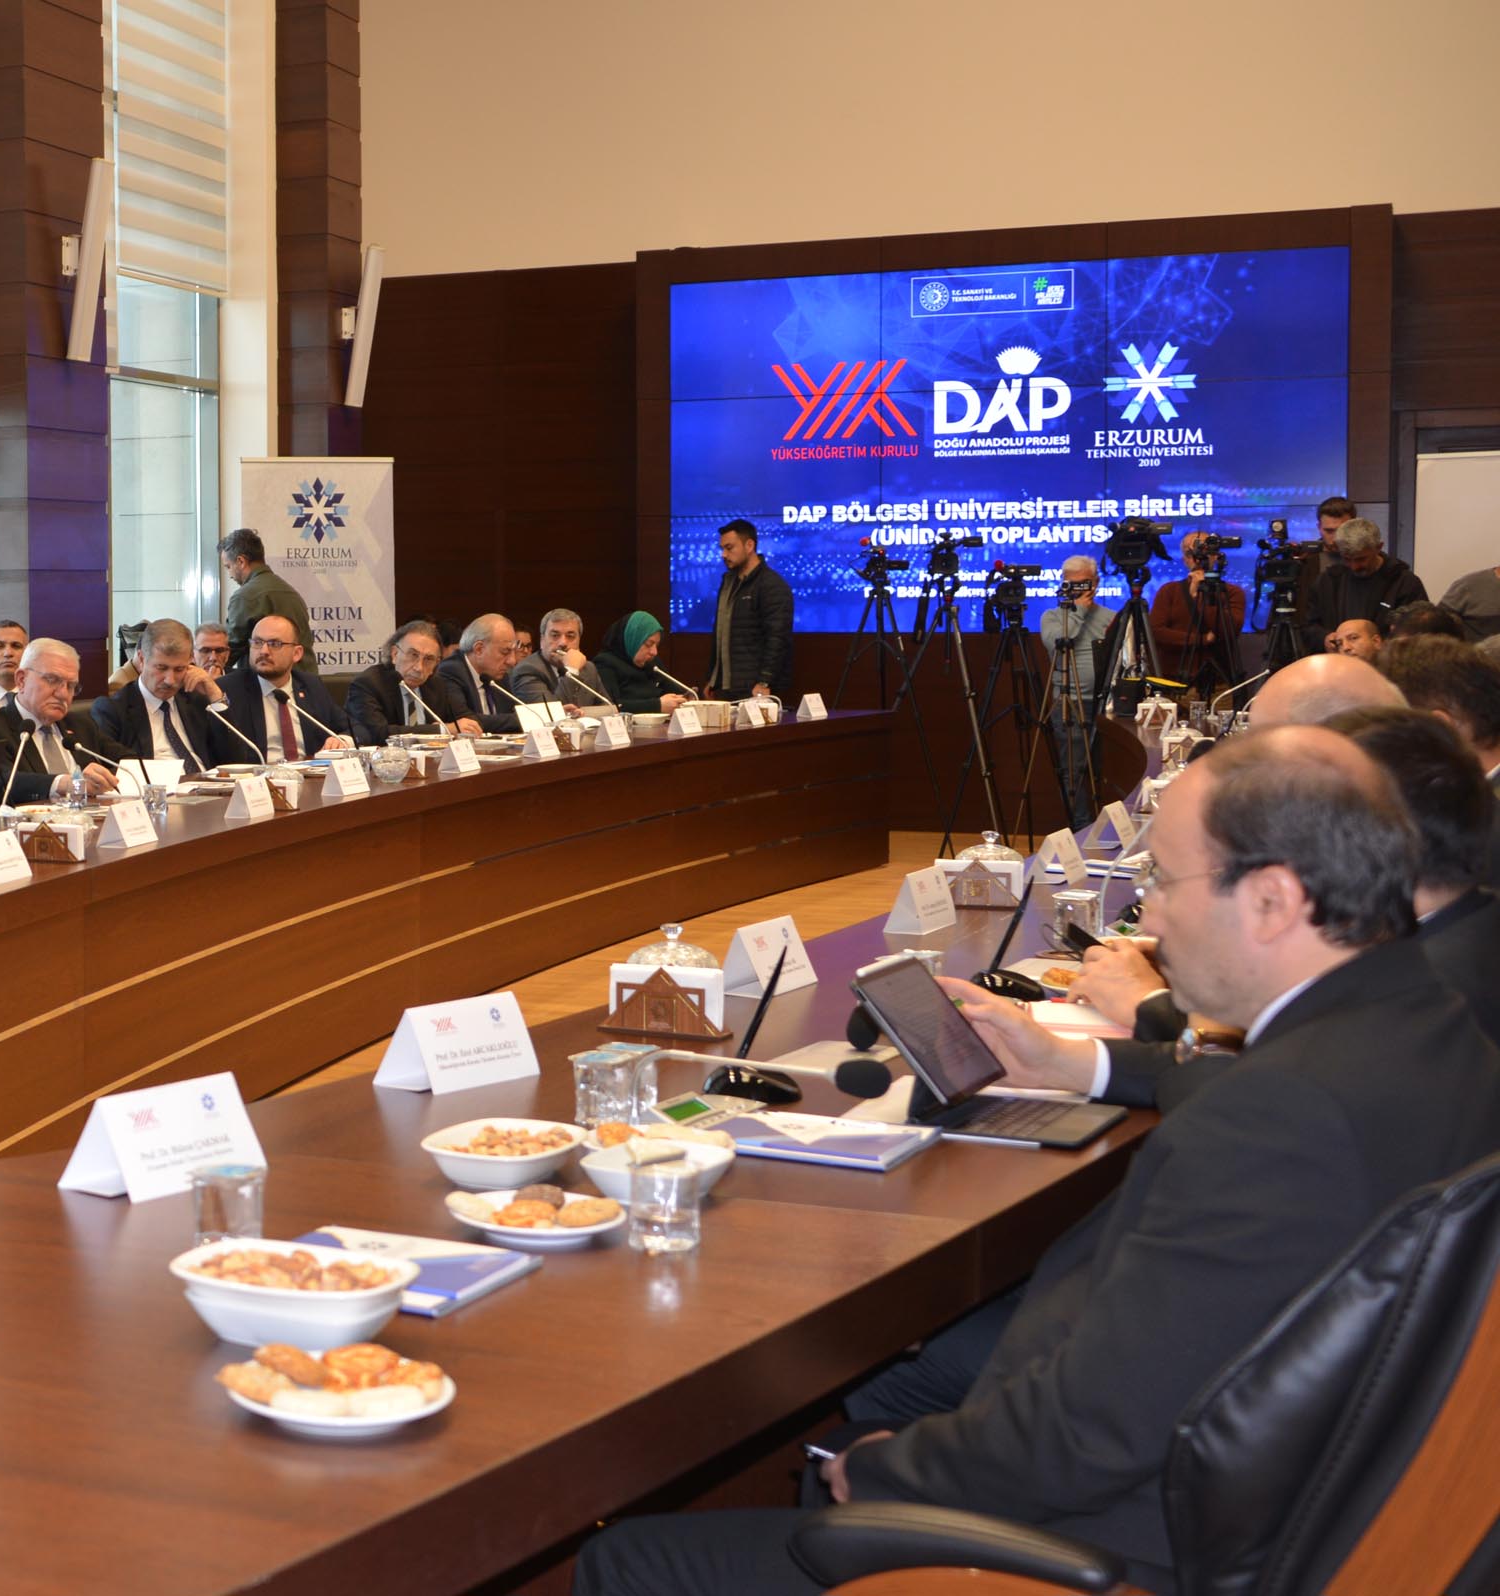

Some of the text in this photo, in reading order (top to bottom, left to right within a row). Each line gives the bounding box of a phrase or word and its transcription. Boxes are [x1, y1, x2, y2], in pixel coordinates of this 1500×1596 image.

[933, 376, 1072, 434] DAP
[934, 434, 1070, 449] DOĞU ANADOLU PROJESİ
[1094, 427, 1205, 447] ERZURUM
[771, 443, 919, 461] YÜKSEKÖĞRETİM KURULU
[934, 449, 958, 457] BÖLGE
[997, 447, 1025, 455] İDARESİ
[1026, 446, 1070, 456] BAŞKANLIĞI
[1084, 443, 1214, 459] TEKNİK ÜNİVERSİTESİ
[1138, 458, 1161, 467] 2010
[783, 494, 1213, 523] DAP BÖLGESİ ÜNİVERSİTELER BİRLİĞİ
[286, 547, 353, 560] ERZURUM
[282, 560, 308, 568] TEKNİK
